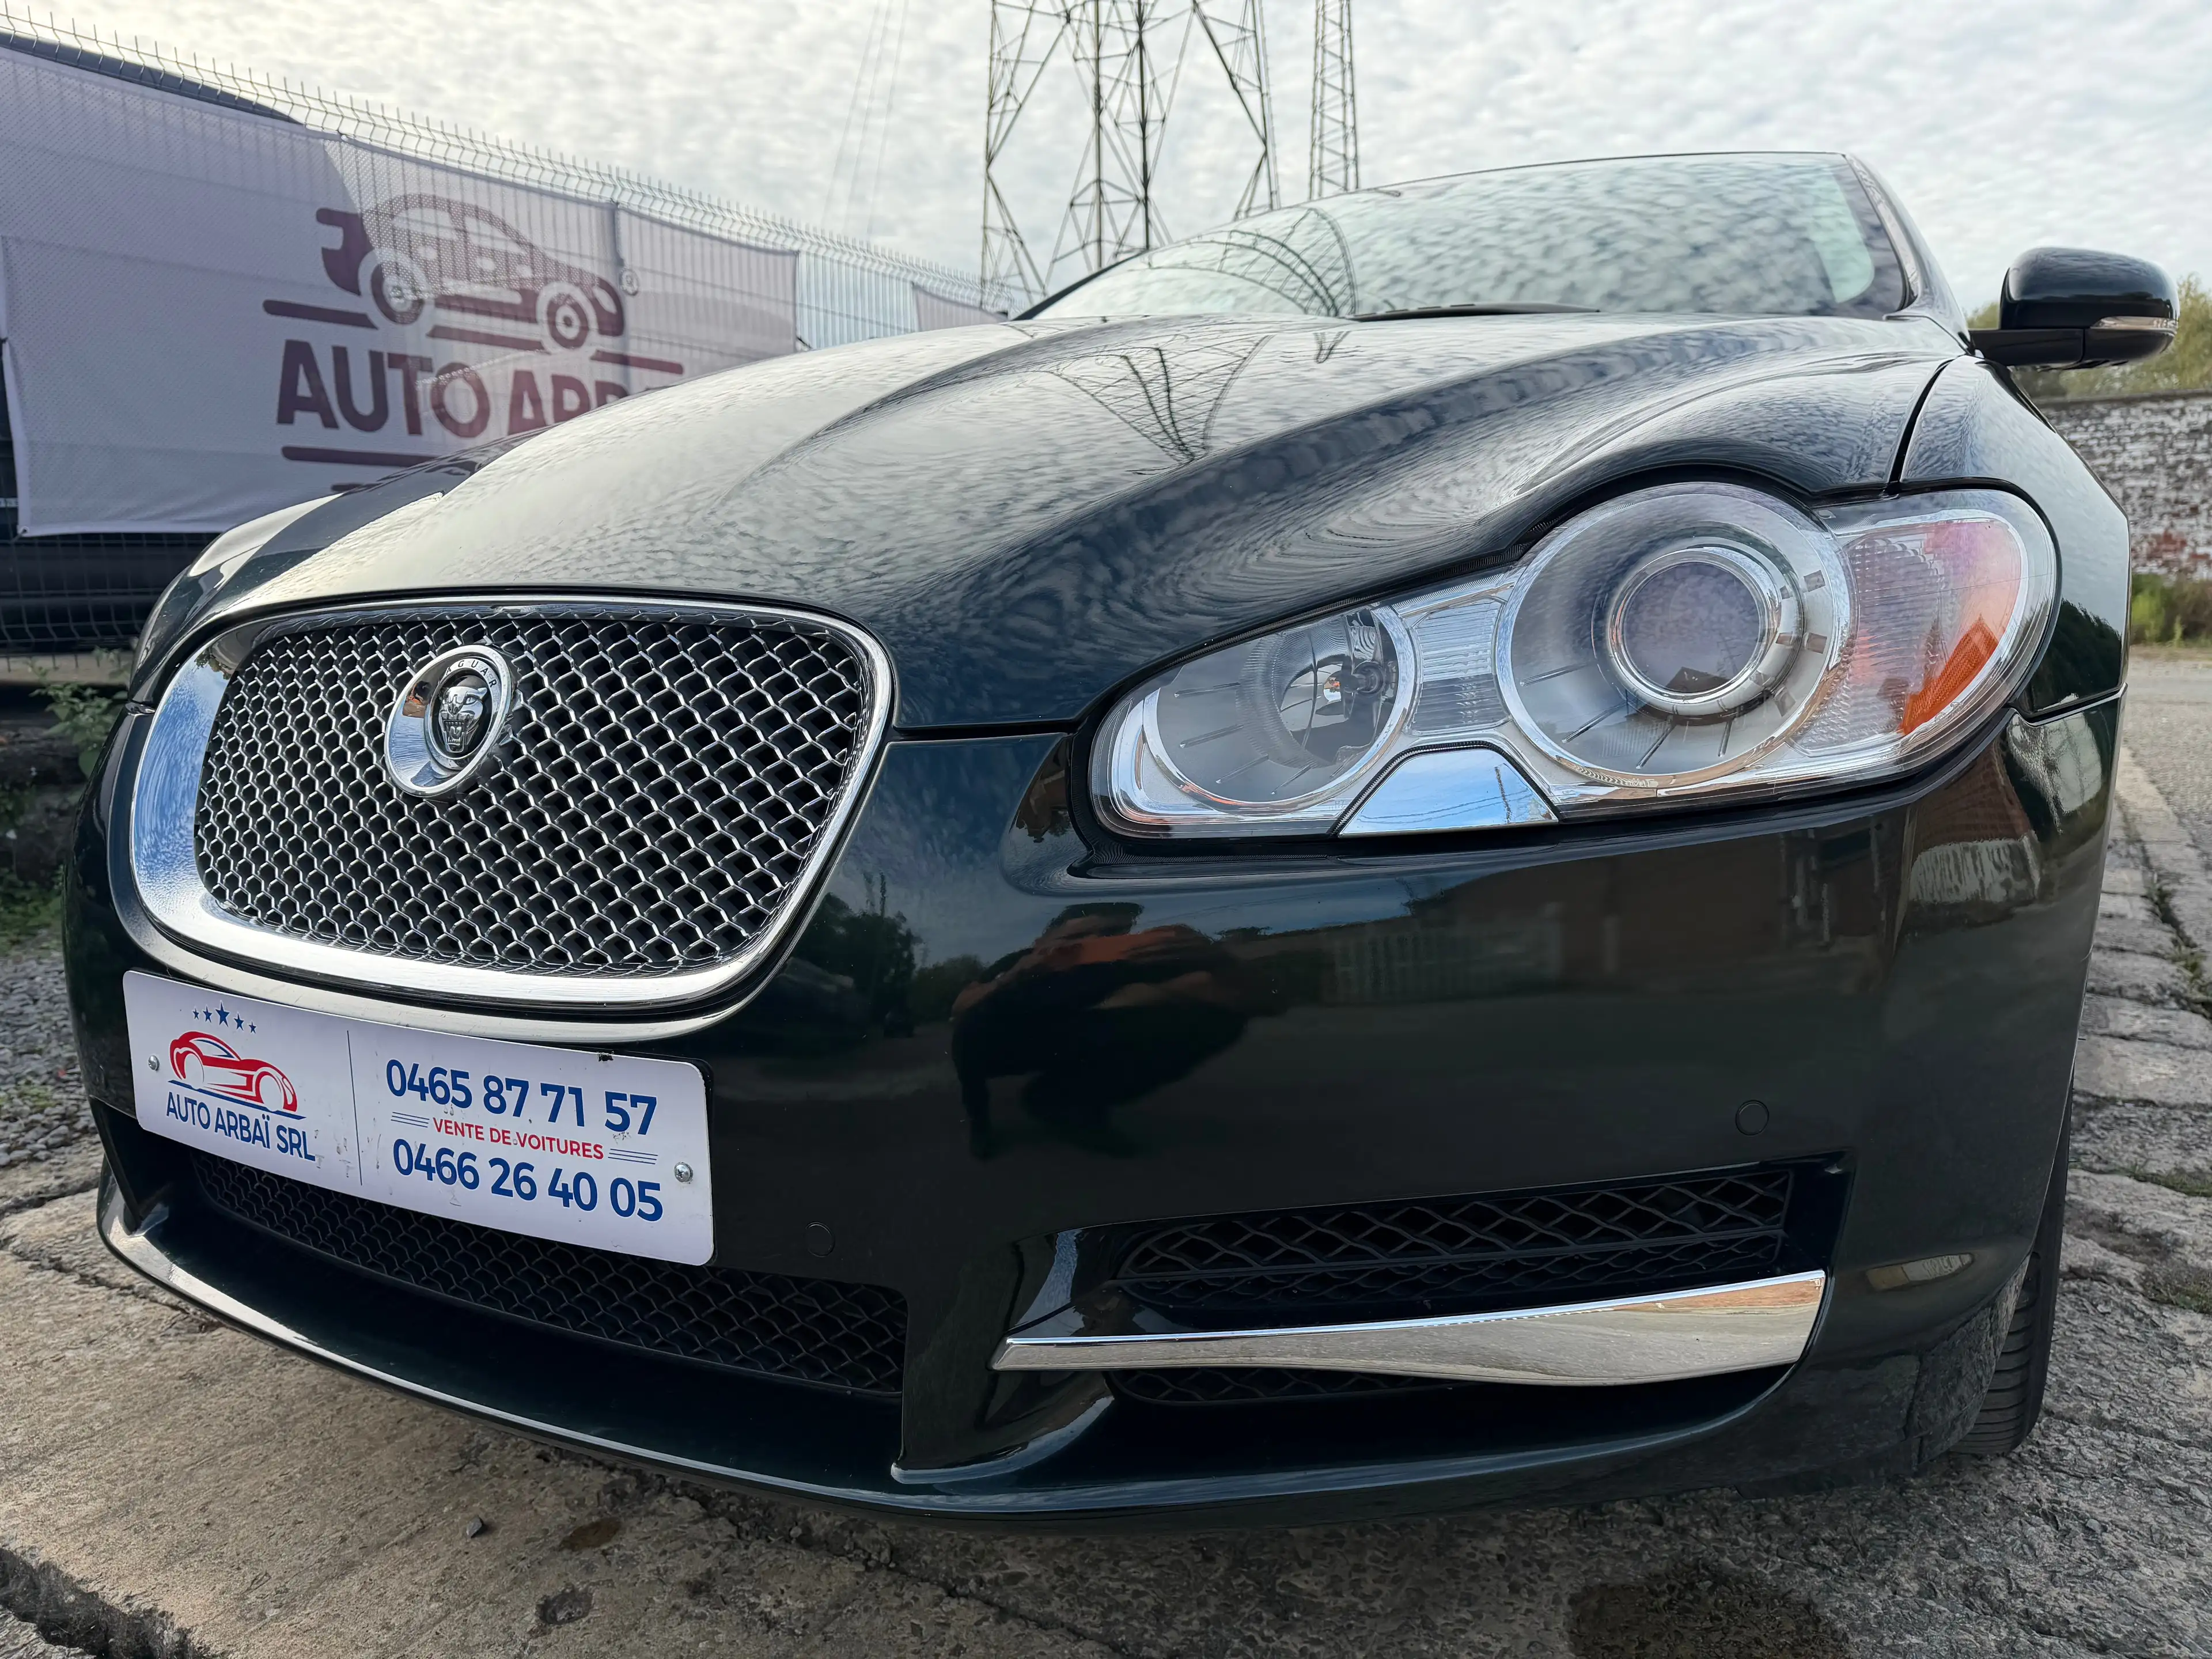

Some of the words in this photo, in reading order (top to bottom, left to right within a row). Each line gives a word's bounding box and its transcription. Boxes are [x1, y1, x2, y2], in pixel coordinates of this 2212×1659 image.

[277, 340, 490, 438] AUTO
[166, 1091, 211, 1130] AUTO
[214, 1107, 271, 1150] ARBAÏ
[276, 1126, 316, 1161] SRL
[386, 1059, 472, 1109] 0465
[483, 1075, 530, 1118] 87
[540, 1082, 585, 1127] 71
[605, 1091, 657, 1135] 57
[433, 1116, 485, 1141] VENTE
[490, 1127, 513, 1143] DE
[516, 1132, 604, 1160] VOITURES
[393, 1139, 480, 1190] 0466
[488, 1157, 537, 1201] 26
[548, 1168, 598, 1211] 40
[609, 1177, 664, 1222] 05
